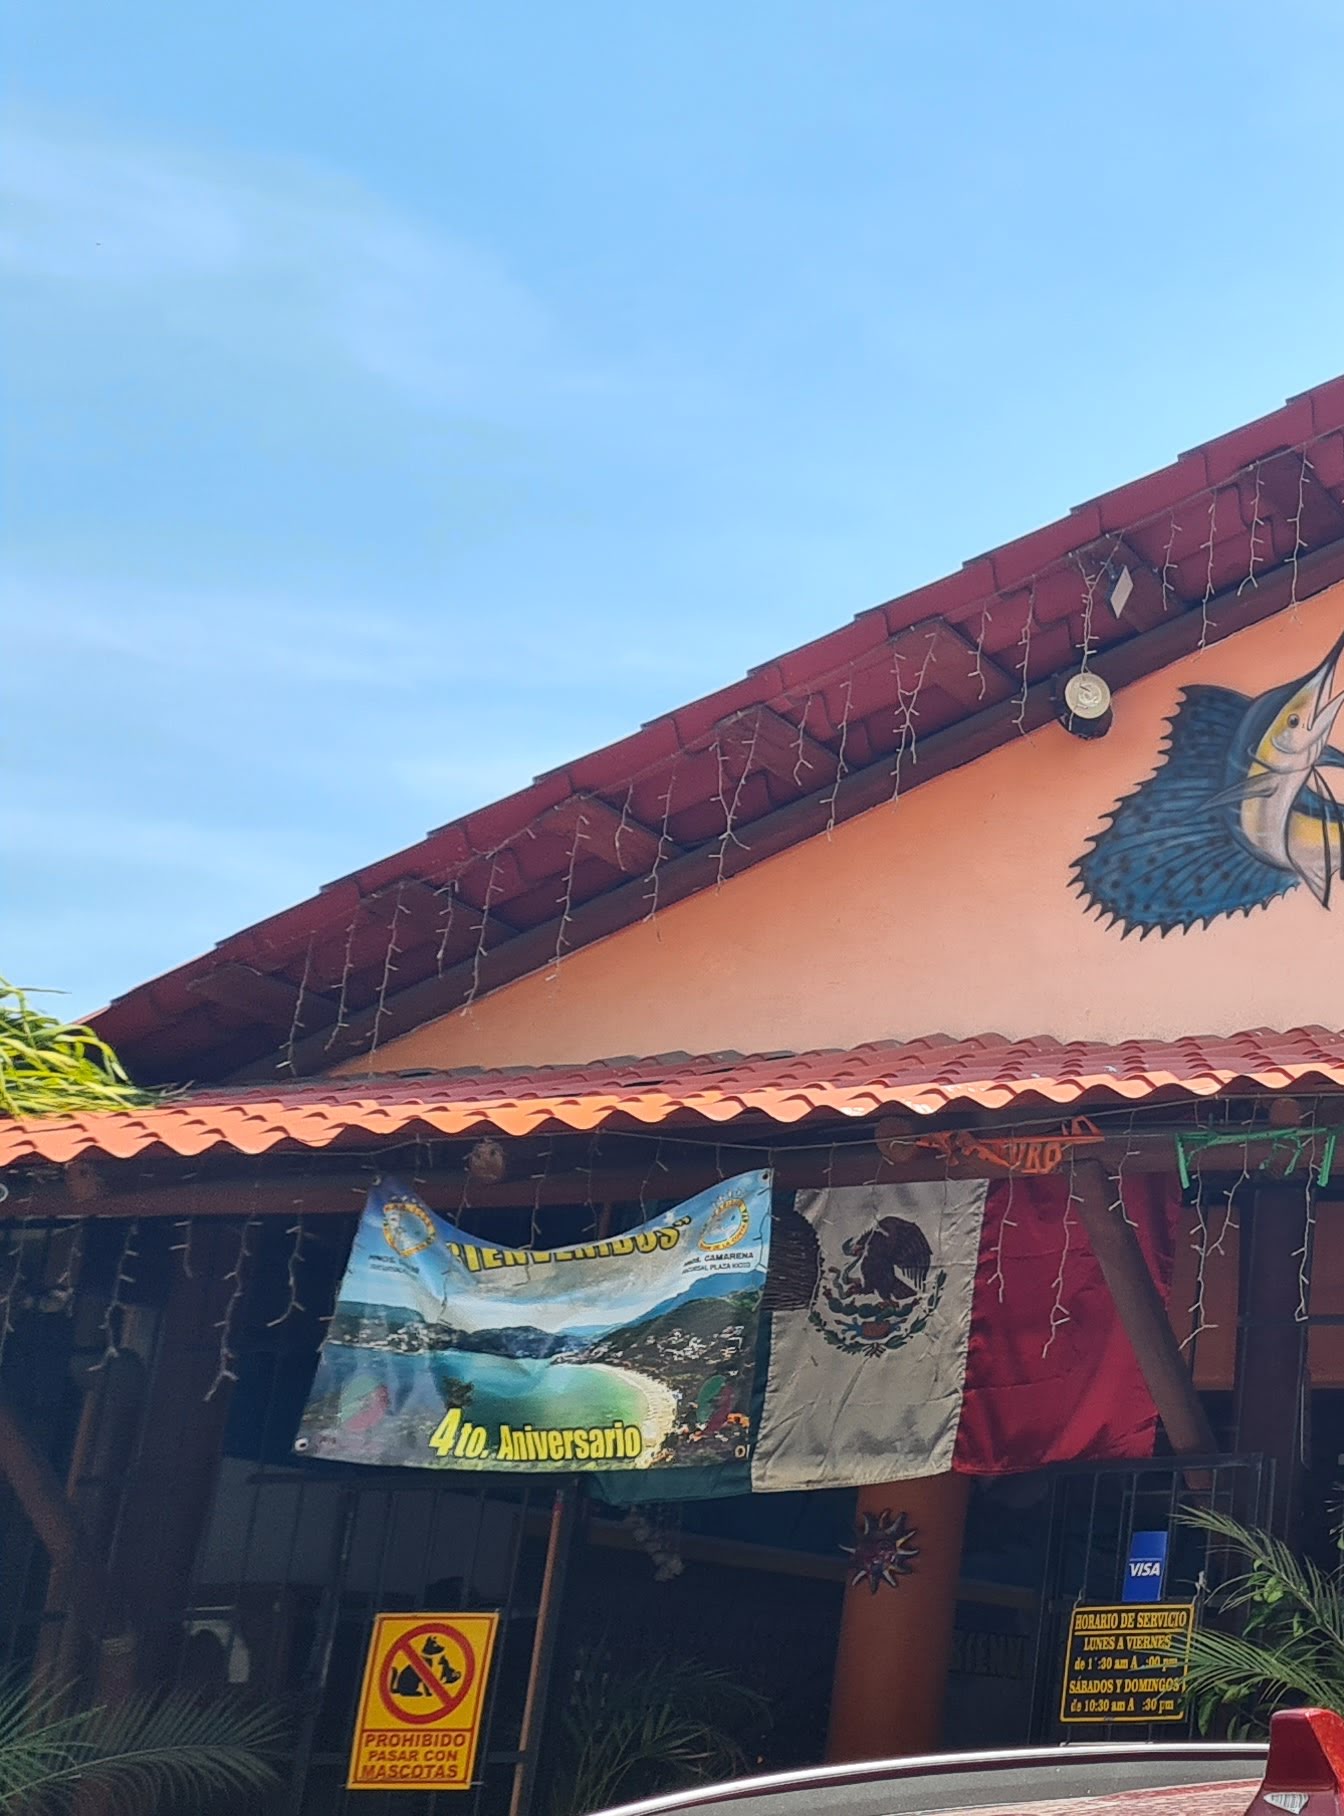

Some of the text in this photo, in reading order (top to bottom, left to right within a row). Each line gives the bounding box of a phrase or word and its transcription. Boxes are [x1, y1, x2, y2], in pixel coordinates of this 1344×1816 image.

[704, 1252, 754, 1262] CAMARENA
[429, 1408, 642, 1461] 4to. Aniversario
[1129, 1562, 1160, 1577] VISA
[1075, 1611, 1187, 1630] HORARIO DE SERVICIO
[1084, 1634, 1172, 1651] LUNES A VIERNES
[1074, 1656, 1085, 1670] de
[1114, 1657, 1128, 1670] am
[1130, 1654, 1138, 1670] A
[1116, 1679, 1123, 1693] Y
[1124, 1677, 1179, 1693] DOMINGOS
[1071, 1698, 1081, 1712] de
[1084, 1698, 1109, 1712] 10:30
[1111, 1699, 1125, 1712] am
[1127, 1697, 1135, 1711] A
[1158, 1699, 1174, 1714] pm
[365, 1733, 466, 1748] PROHIBIDO
[368, 1750, 458, 1762] PASAR CON
[362, 1764, 458, 1779] MASCOTAS
